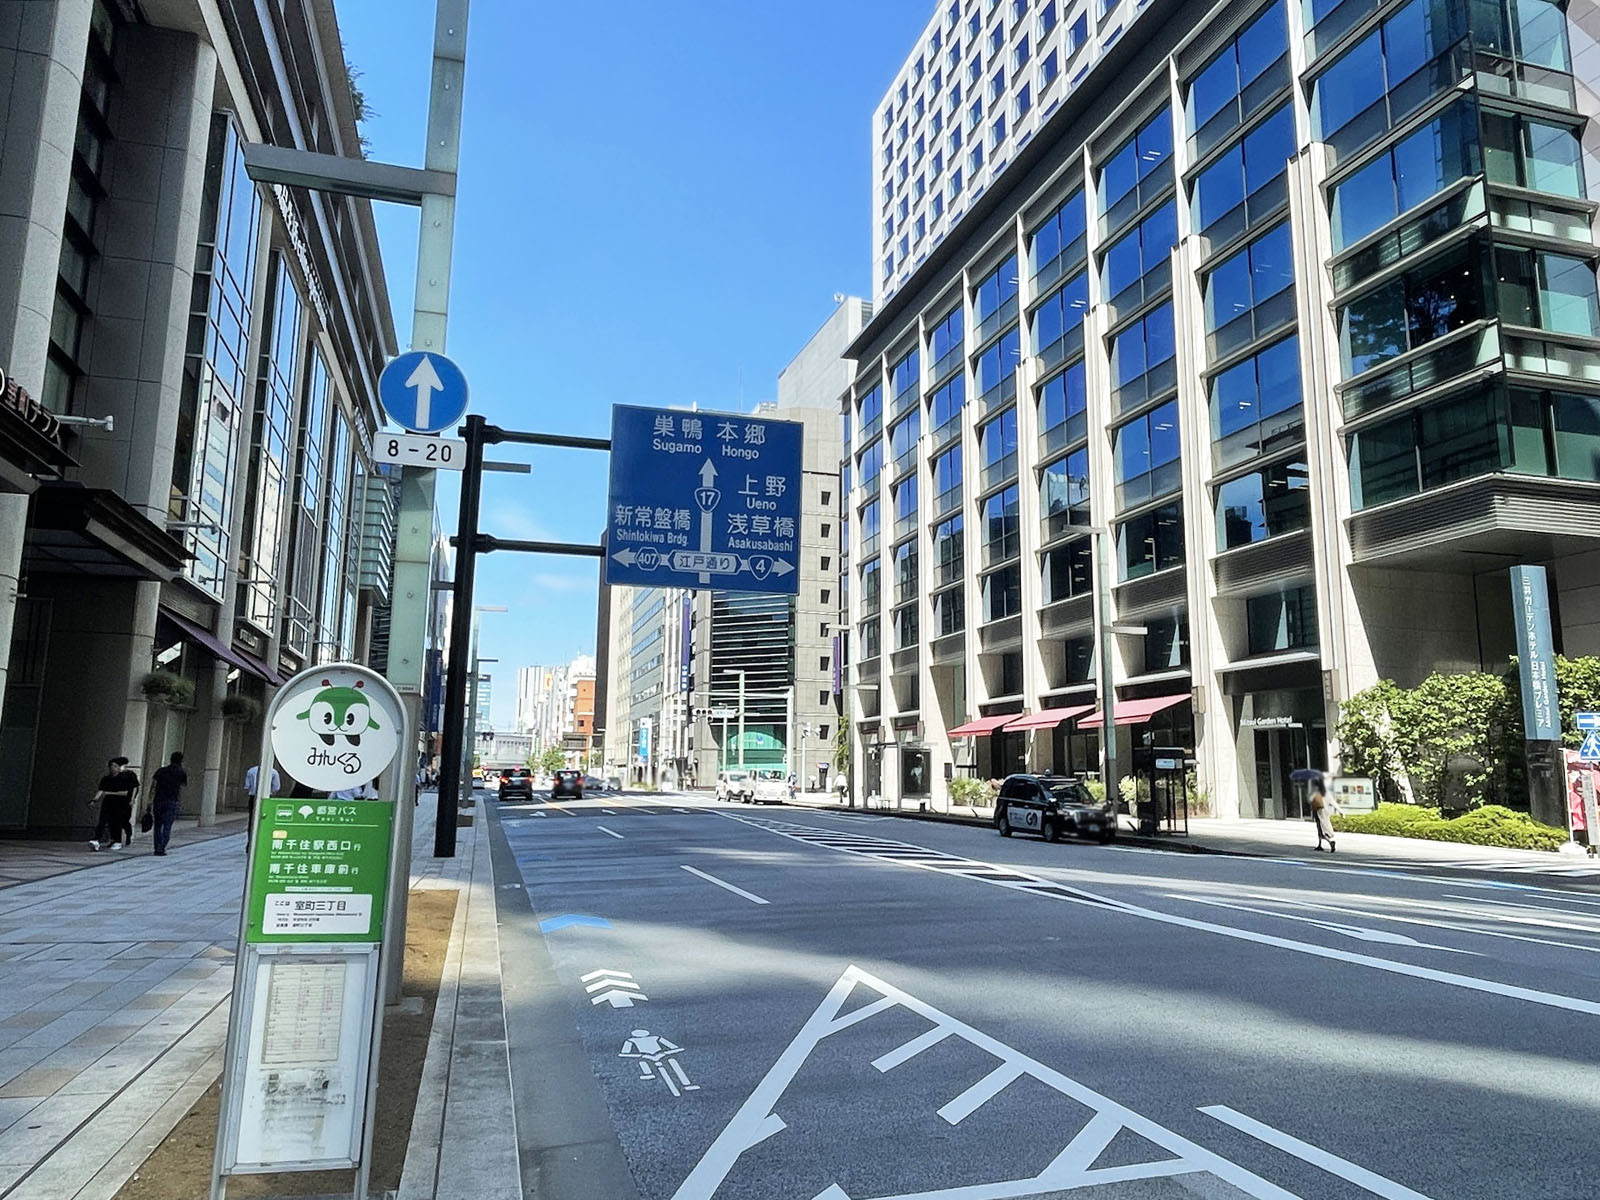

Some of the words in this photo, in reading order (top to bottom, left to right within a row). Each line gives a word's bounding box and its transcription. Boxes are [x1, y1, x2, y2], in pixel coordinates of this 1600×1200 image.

[653, 414, 703, 440] 巣鴨
[716, 421, 766, 445] 本郷
[653, 439, 702, 454] Sugamo
[721, 445, 760, 460] Hongo
[738, 474, 786, 497] 上野
[699, 491, 714, 505] 17
[746, 497, 777, 511] Ueno
[615, 504, 691, 531] 新常盤橋
[727, 513, 795, 539] 浅草橋
[616, 529, 665, 544] Shintokiwa
[728, 536, 793, 552] Asakusabashi
[638, 553, 657, 565] 407
[679, 555, 731, 570] 江戸通り
[755, 559, 766, 573] 4
[306, 747, 362, 774] みんくる
[294, 900, 347, 911] 室町三丁目
